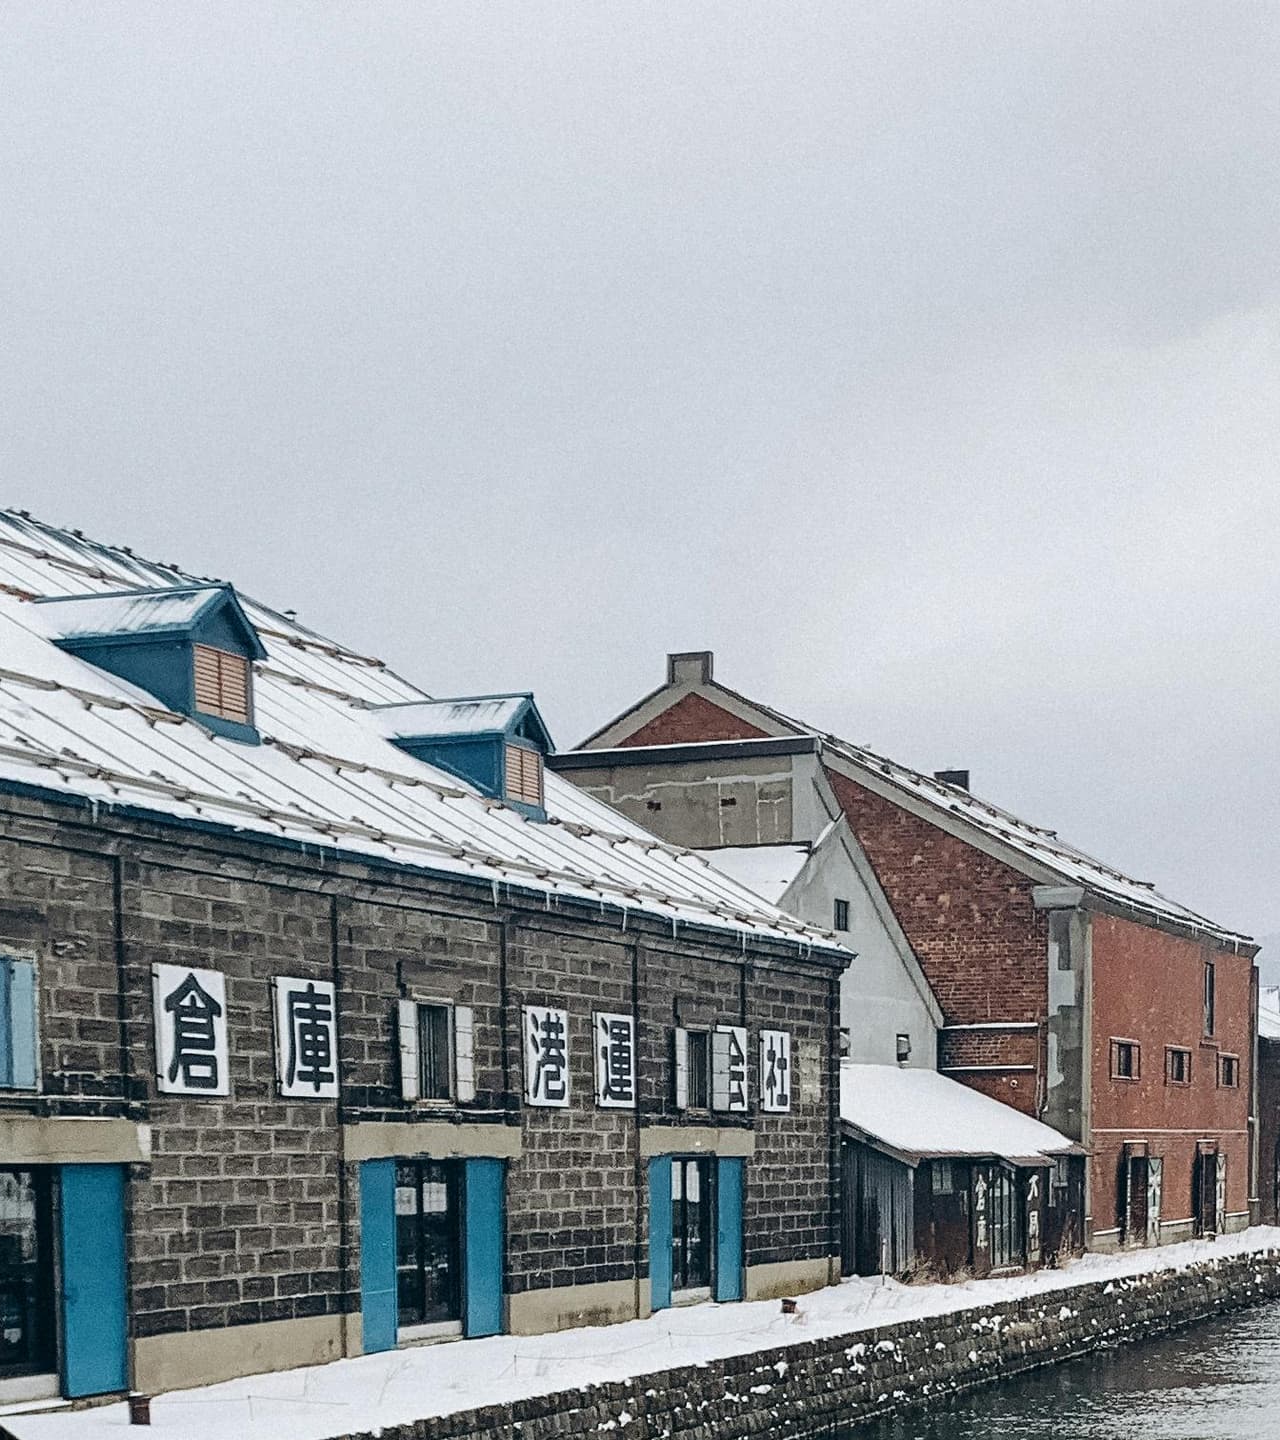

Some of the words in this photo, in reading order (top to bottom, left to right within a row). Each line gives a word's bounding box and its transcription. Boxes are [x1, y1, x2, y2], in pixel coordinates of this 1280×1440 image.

[164, 972, 222, 1089] 倉
[287, 982, 335, 1093] 庫
[530, 1012, 566, 1100] 港
[600, 1017, 633, 1101] 運
[765, 1034, 788, 1107] 社
